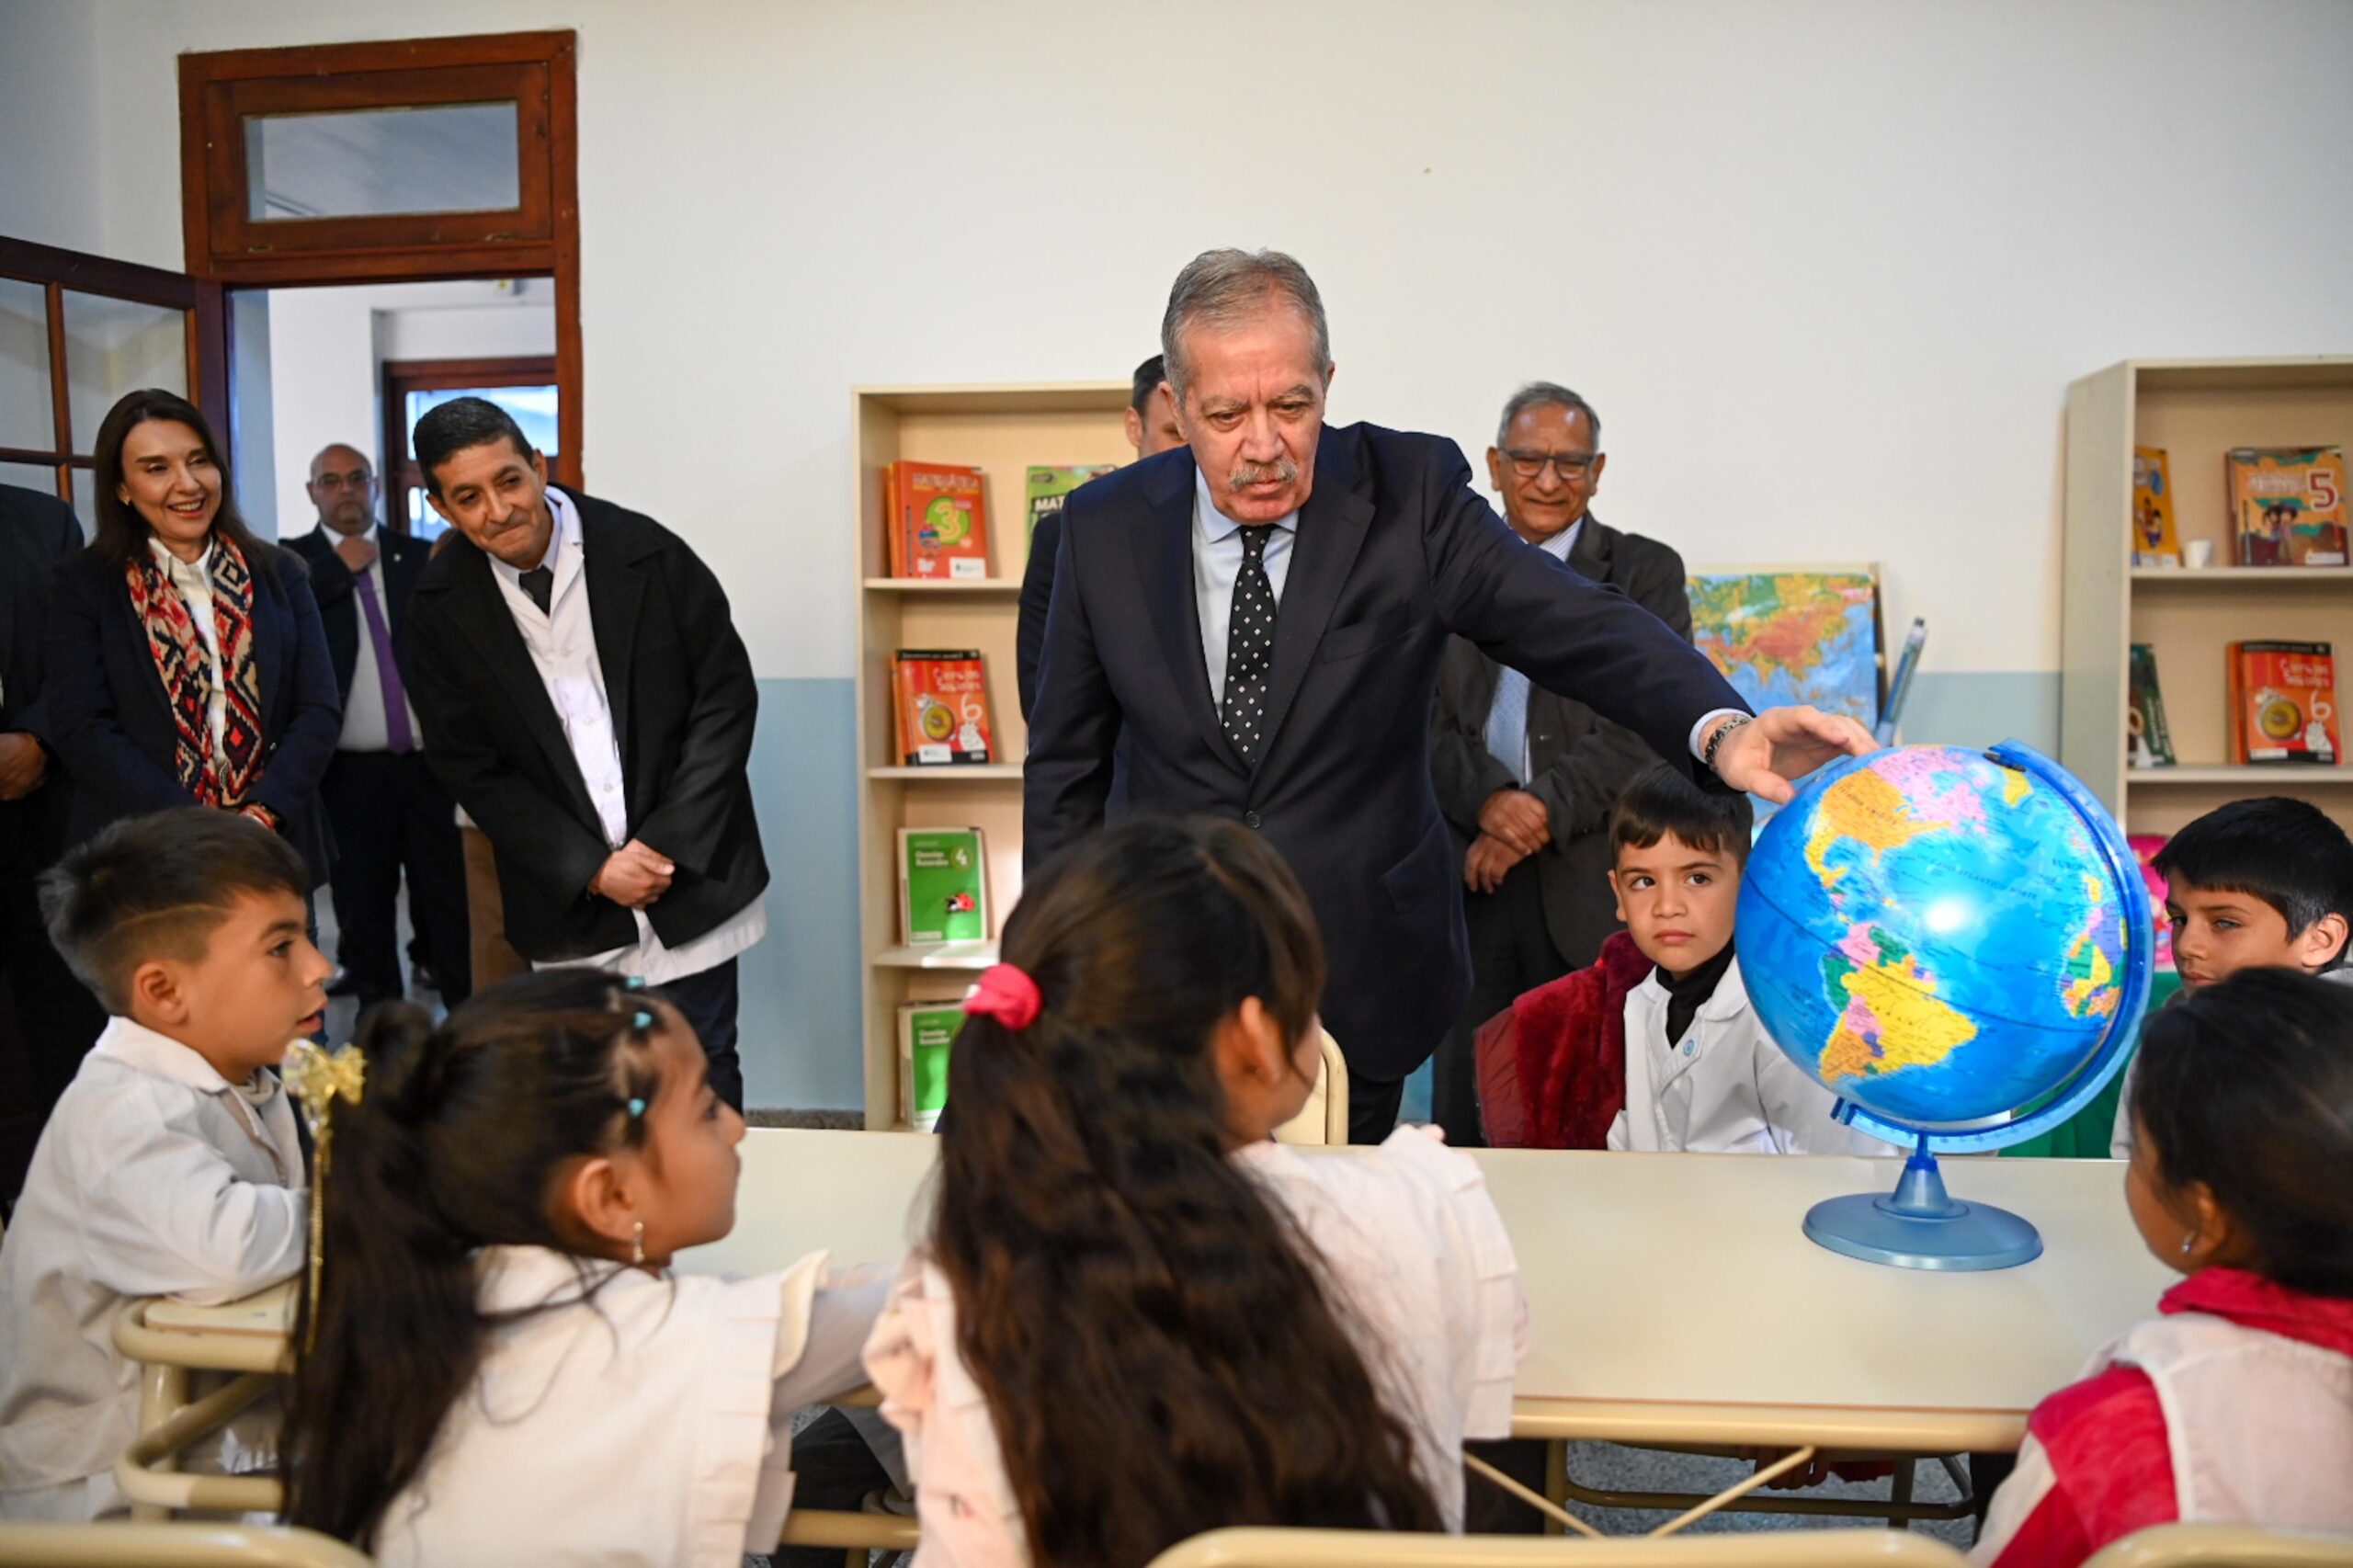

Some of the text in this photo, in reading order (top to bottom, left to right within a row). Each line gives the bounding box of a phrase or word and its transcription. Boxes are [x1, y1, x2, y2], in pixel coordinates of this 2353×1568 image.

[2309, 472, 2337, 509] 5
[935, 501, 961, 542] 3
[961, 693, 983, 722] 6
[2310, 689, 2332, 722] 6
